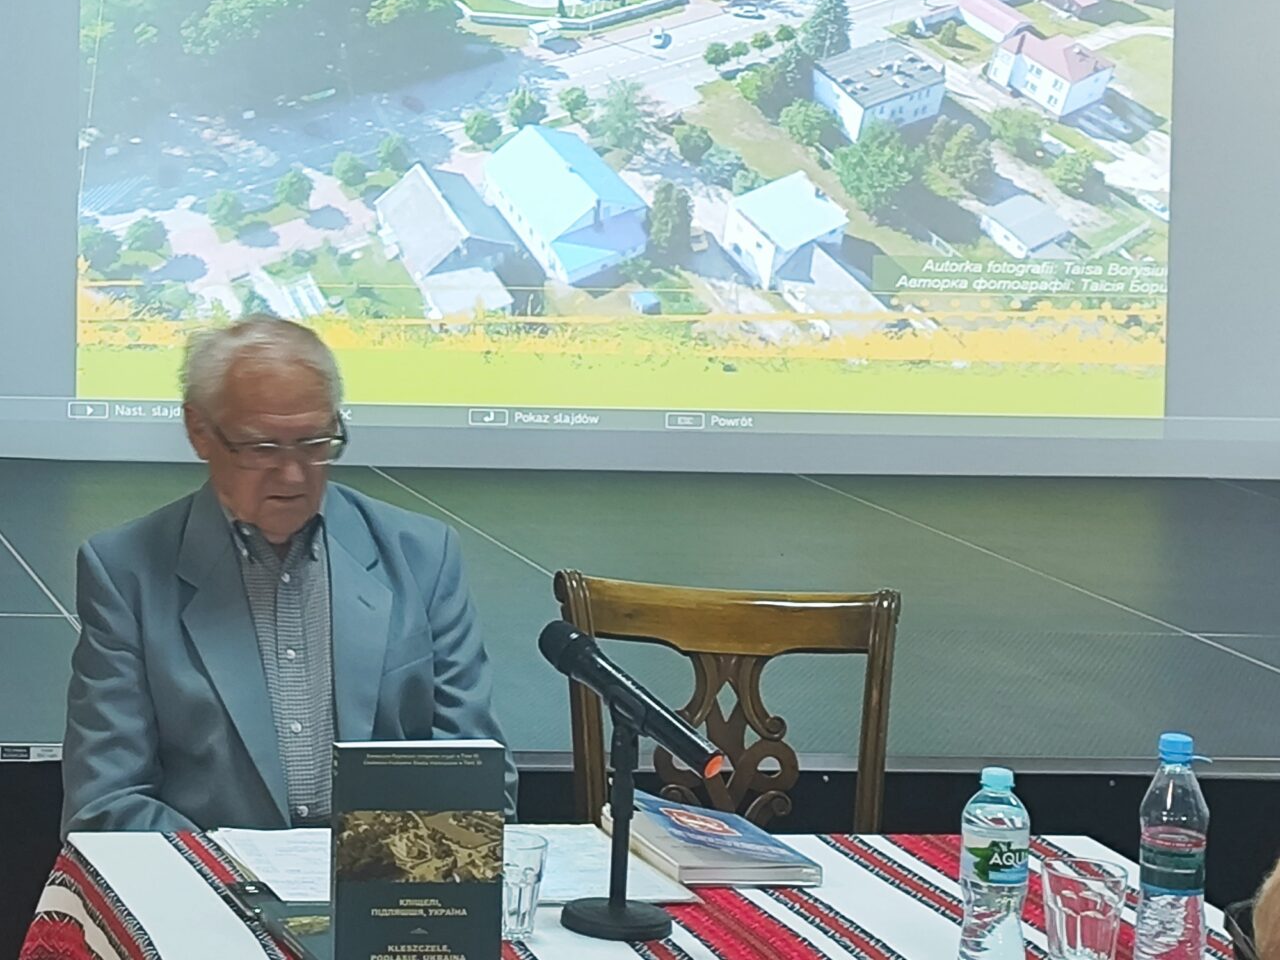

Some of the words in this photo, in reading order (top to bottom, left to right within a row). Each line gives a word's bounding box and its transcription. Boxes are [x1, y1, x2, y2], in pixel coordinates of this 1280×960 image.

[922, 259, 982, 274] Autorka
[1063, 261, 1103, 276] Taisa
[895, 275, 969, 291] Авторка
[114, 404, 147, 417] Nast.
[514, 411, 550, 424] Pokaz
[553, 412, 600, 426] slajdów
[710, 415, 754, 428] Powrót
